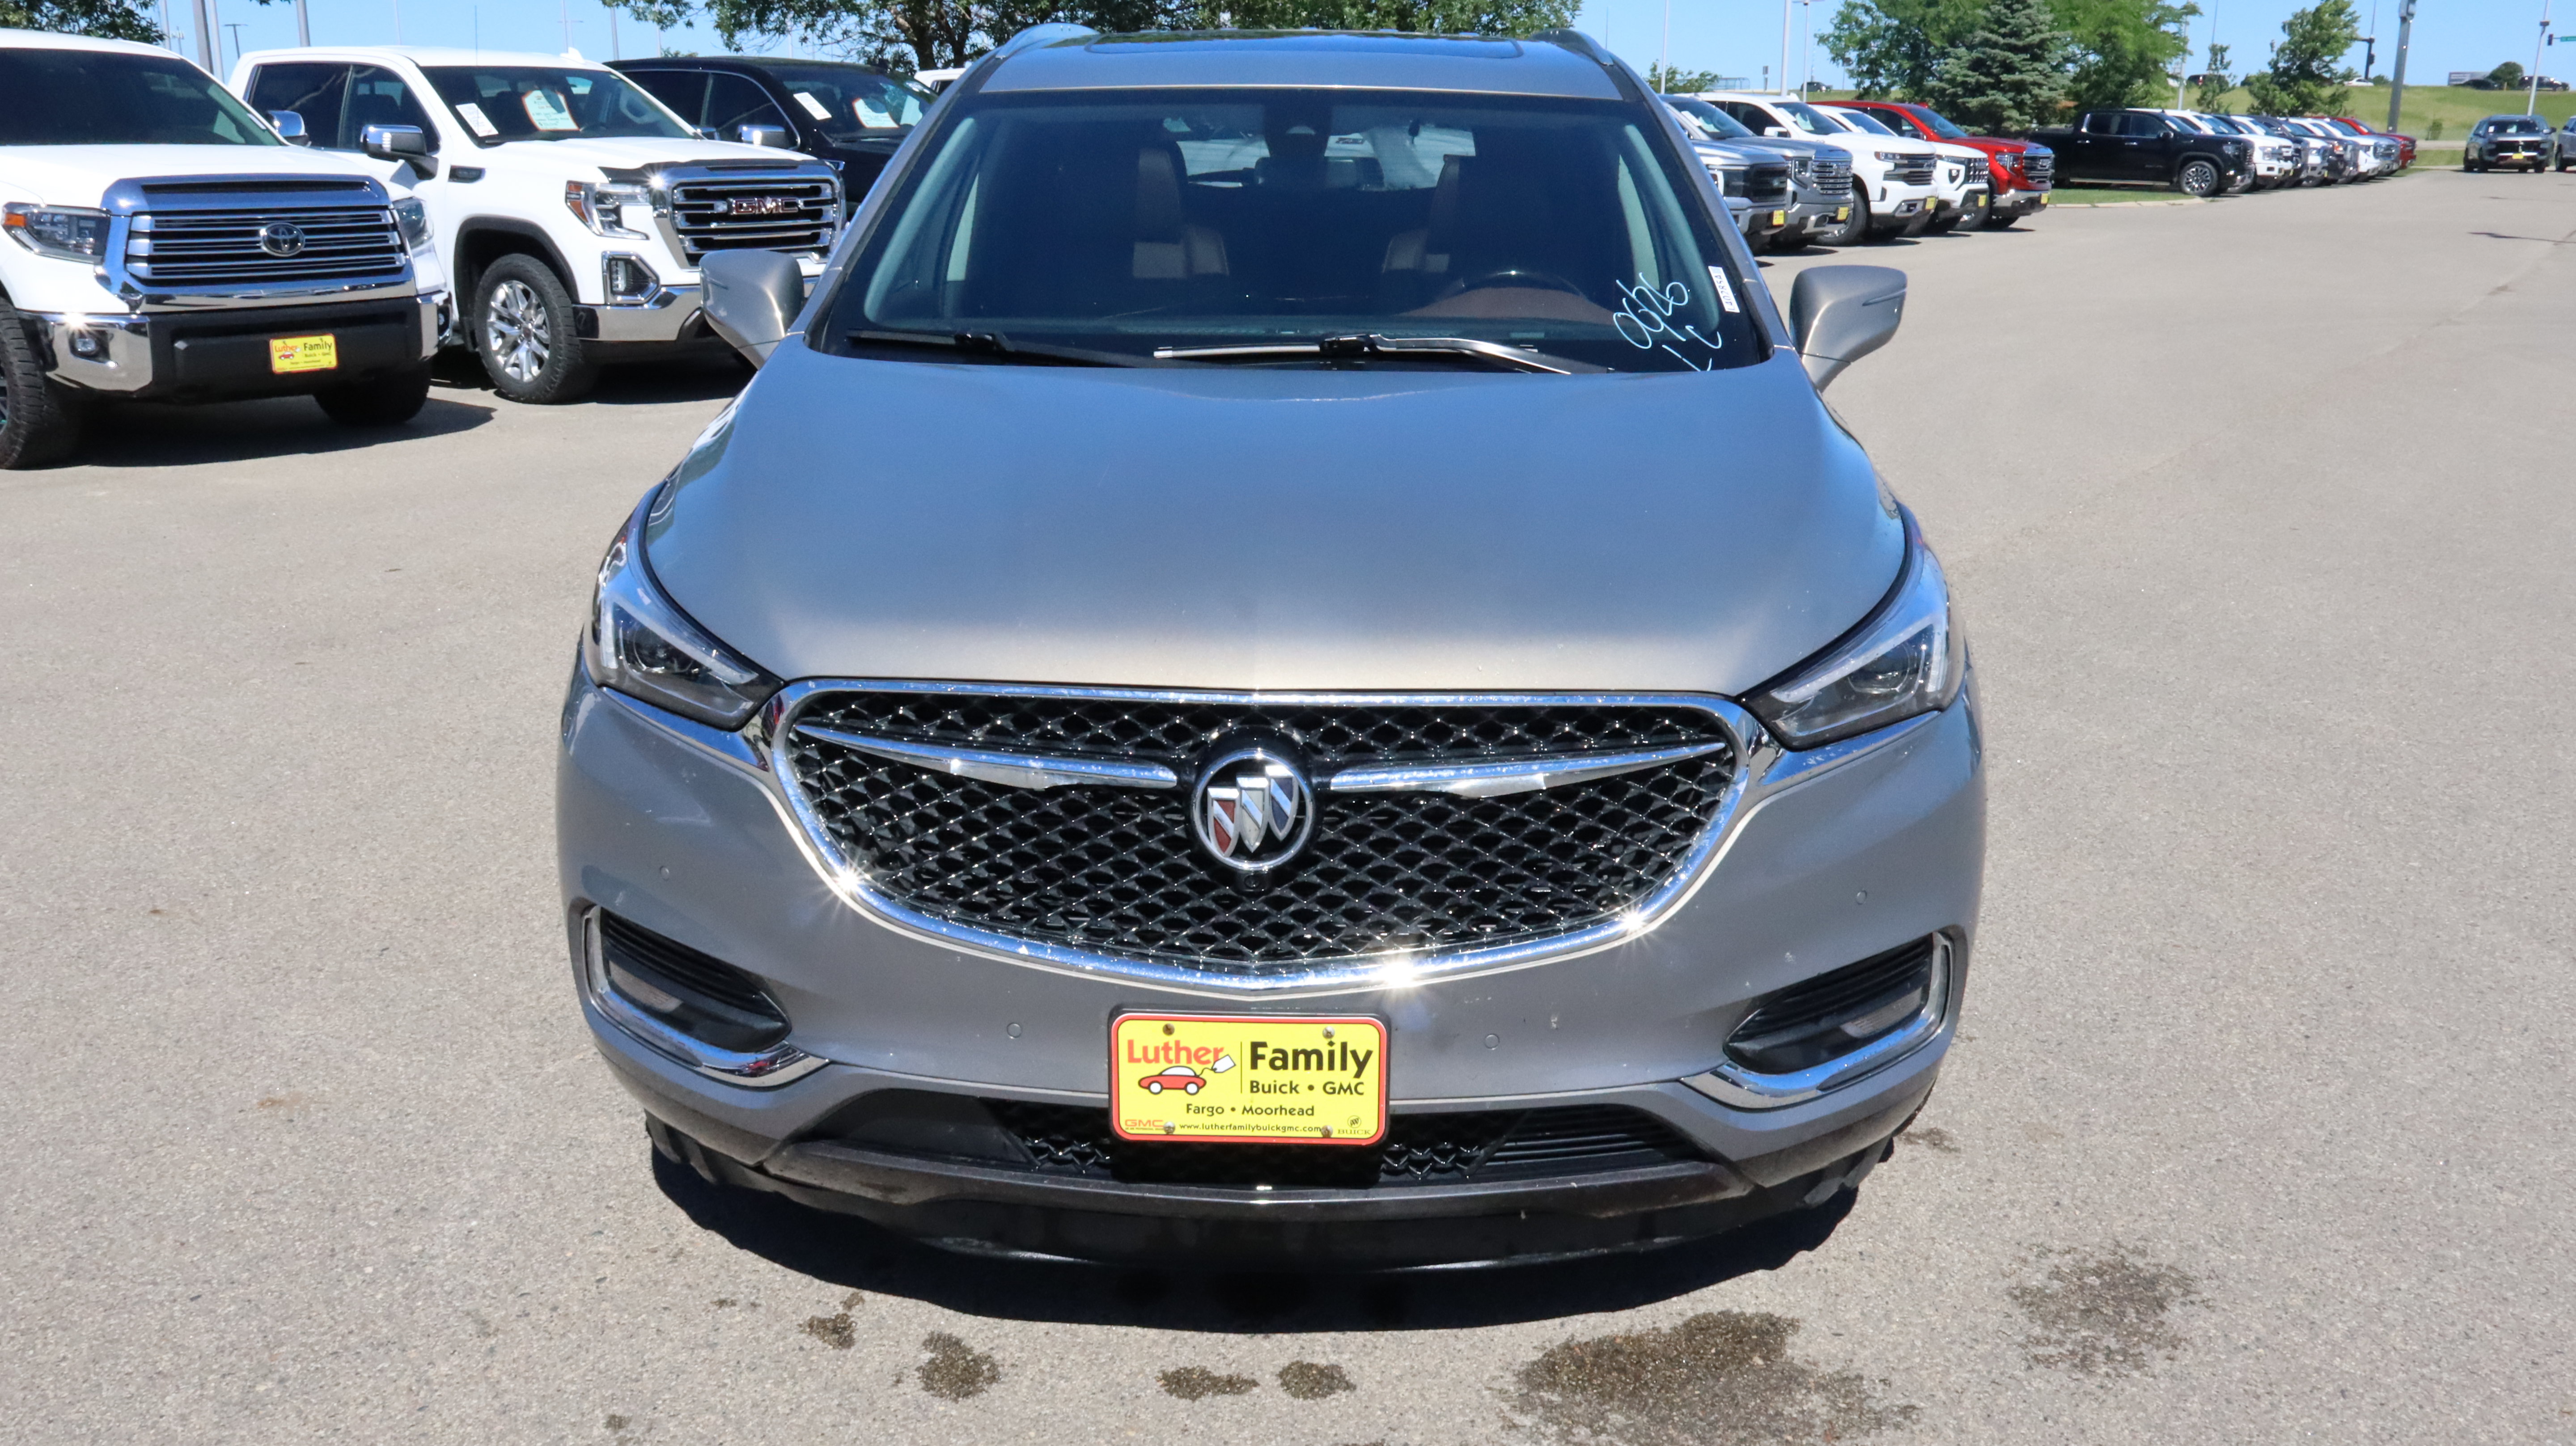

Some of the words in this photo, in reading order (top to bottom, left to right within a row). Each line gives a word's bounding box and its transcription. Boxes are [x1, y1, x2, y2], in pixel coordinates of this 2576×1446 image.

[733, 197, 798, 214] GMC
[304, 341, 332, 351] Family
[1127, 1039, 1224, 1065] Luther
[1250, 1040, 1373, 1079] Family
[1250, 1080, 1300, 1094] Buick
[1322, 1081, 1364, 1095] GMC
[1186, 1103, 1224, 1116] Fargo
[1241, 1105, 1314, 1116] Moorhead
[1125, 1119, 1164, 1127] GMC
[1179, 1123, 1322, 1133] www.lutherfamilybuickgmc.com
